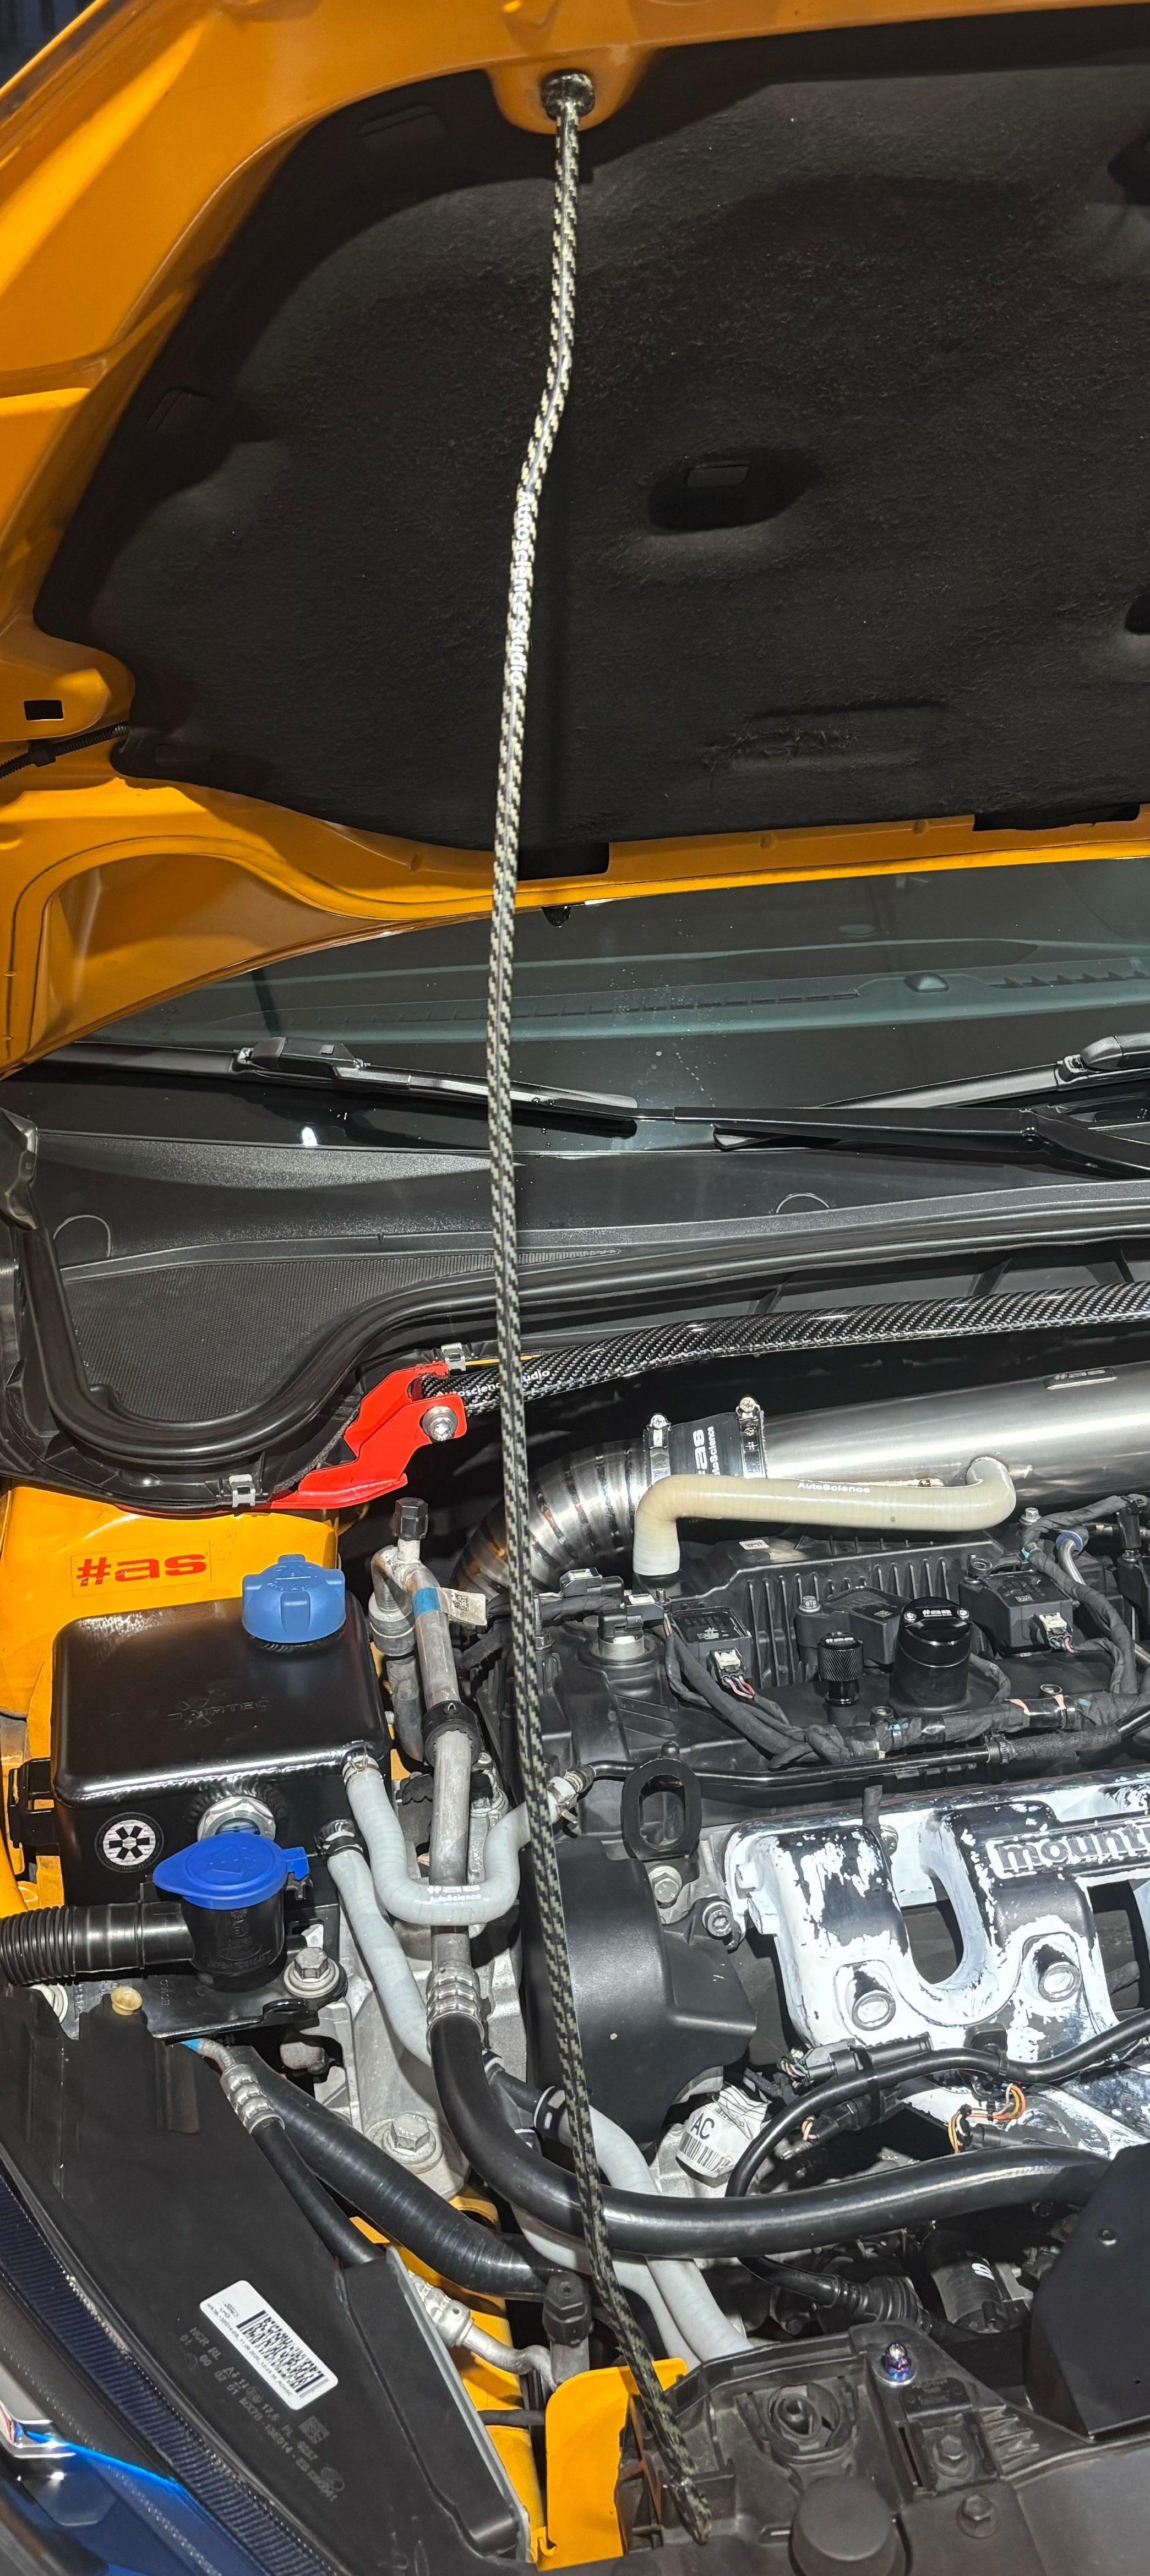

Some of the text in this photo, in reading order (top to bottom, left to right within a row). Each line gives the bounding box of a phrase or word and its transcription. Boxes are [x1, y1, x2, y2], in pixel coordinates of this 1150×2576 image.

[510, 620, 528, 685] Studio
[76, 1554, 207, 1587] #as
[690, 2112, 715, 2140] AC
